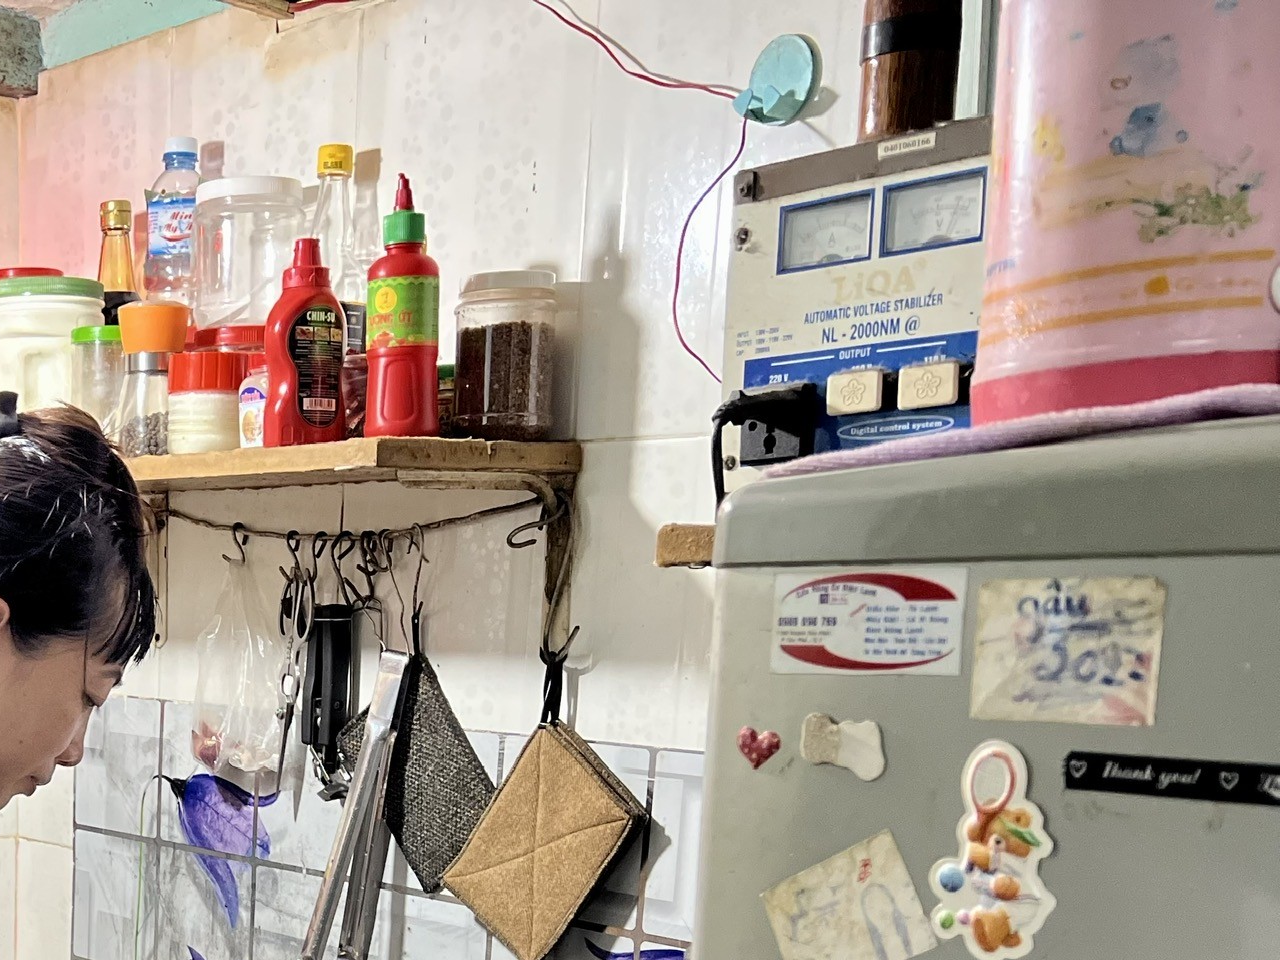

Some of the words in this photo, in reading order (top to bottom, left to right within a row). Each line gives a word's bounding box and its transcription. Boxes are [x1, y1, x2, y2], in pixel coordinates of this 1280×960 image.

[803, 306, 852, 325] AUTOMATIC
[853, 301, 891, 318] VOLTAGE
[893, 293, 944, 312] STABILIZER
[306, 311, 336, 323] CHIN-SU
[821, 328, 838, 344] NL
[850, 318, 901, 339] 2000NM
[839, 347, 871, 360] OUTPUT
[768, 374, 783, 384] 220
[850, 425, 878, 436] Digital
[879, 422, 910, 432] control
[911, 421, 943, 431] system
[1102, 760, 1155, 781] Thank
[1156, 768, 1202, 789] you!
